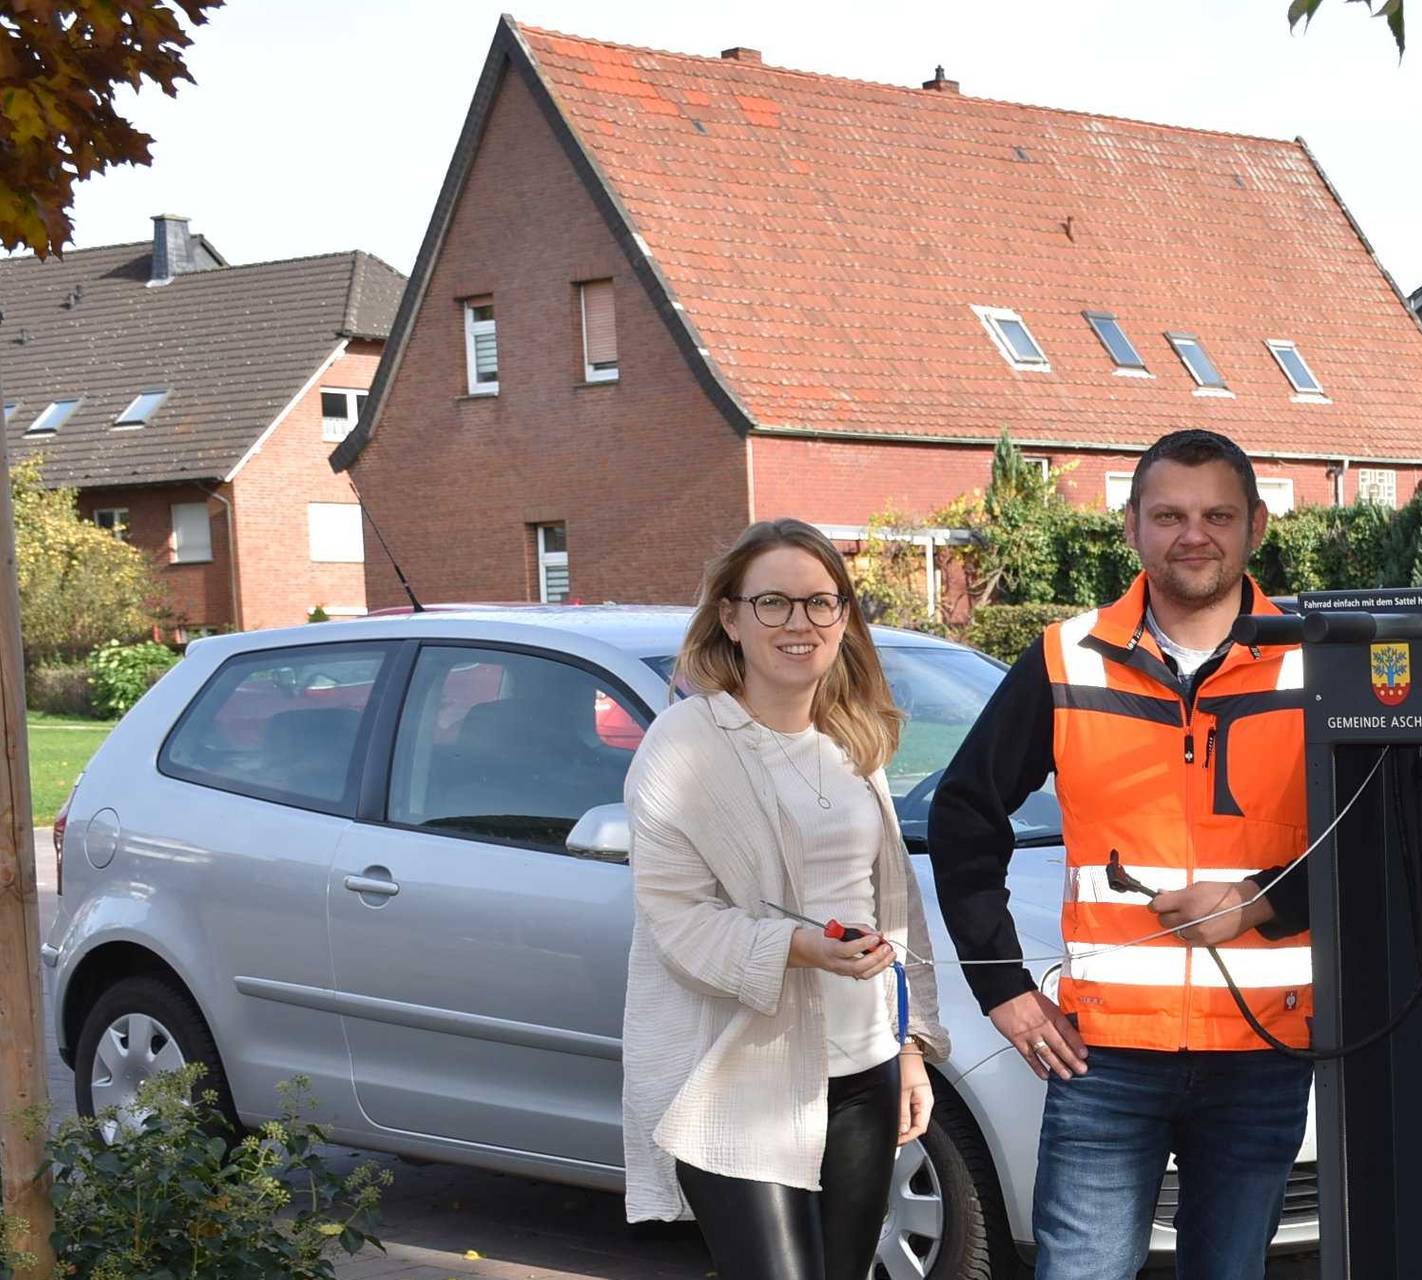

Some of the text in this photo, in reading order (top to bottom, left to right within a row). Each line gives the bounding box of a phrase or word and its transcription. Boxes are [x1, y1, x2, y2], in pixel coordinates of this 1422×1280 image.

[1303, 600, 1332, 609] Fahrrad
[1333, 599, 1361, 608] einfach
[1362, 598, 1375, 607] mit
[1376, 598, 1393, 606] dem
[1394, 597, 1417, 606] Sattel
[1328, 716, 1387, 729] GEMEINDE
